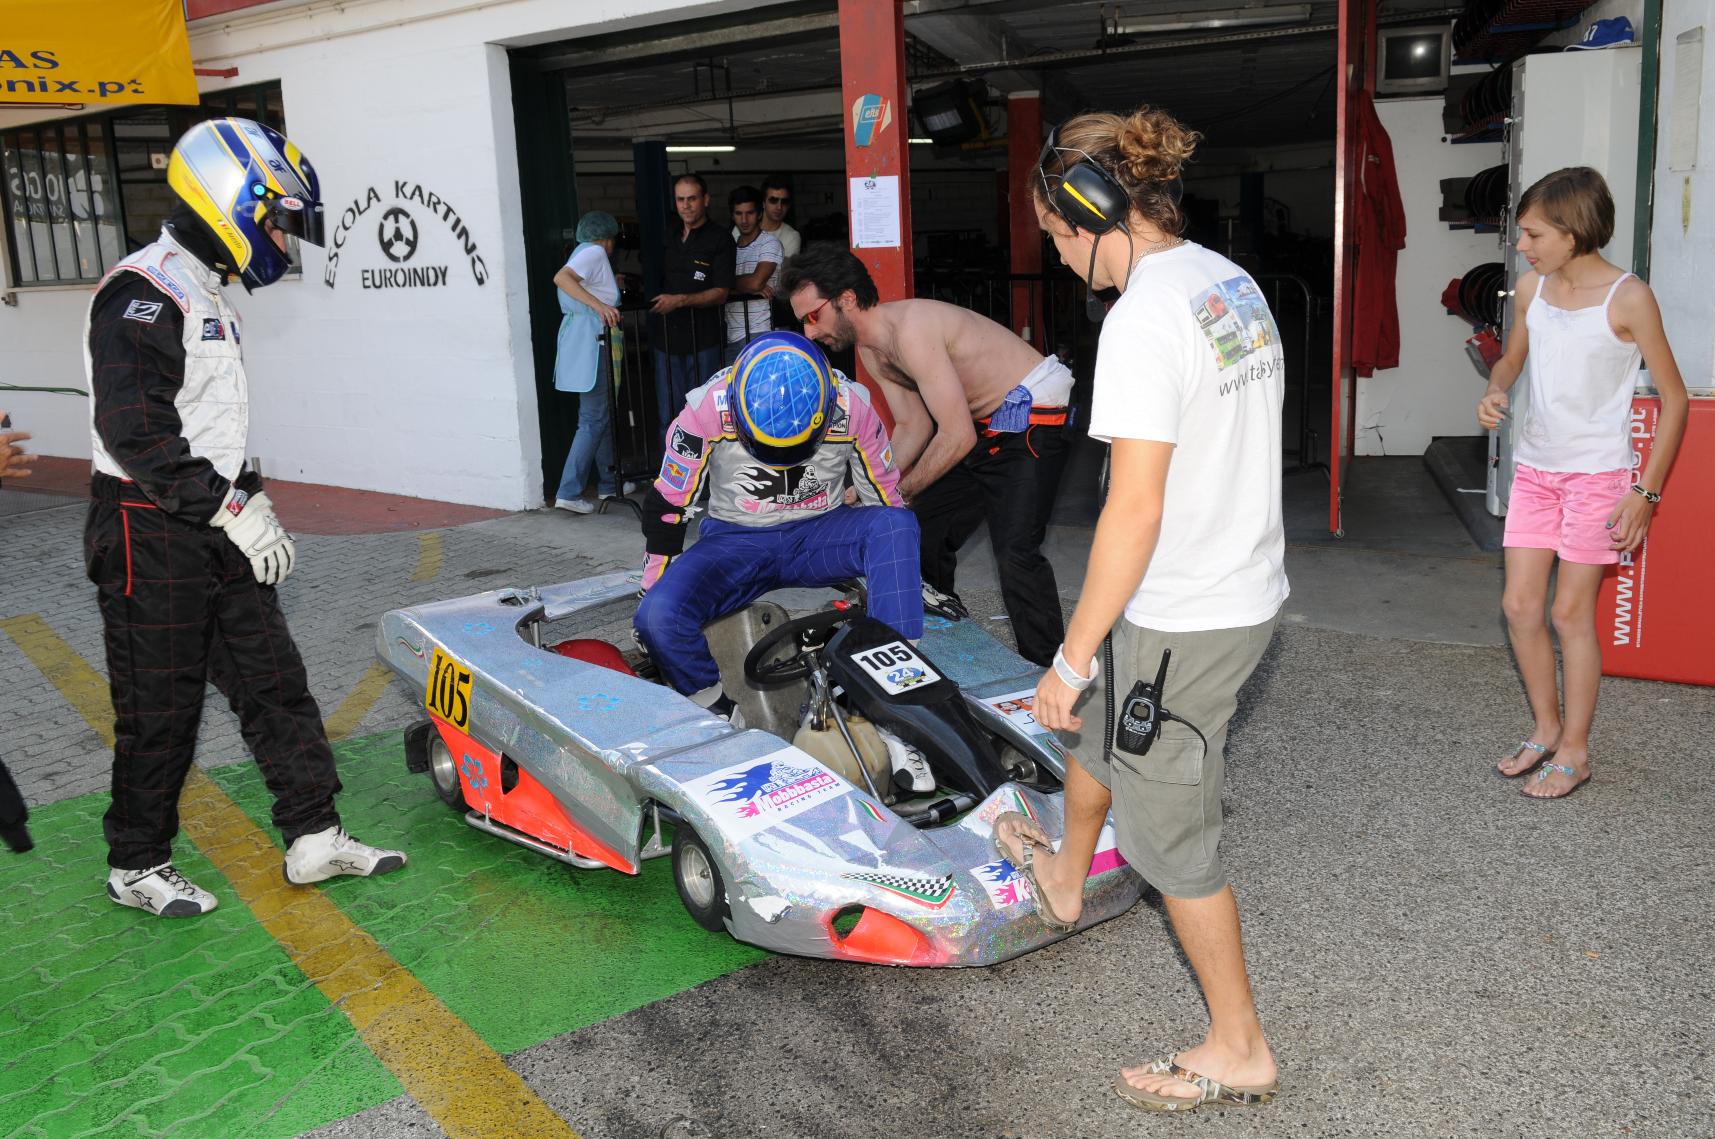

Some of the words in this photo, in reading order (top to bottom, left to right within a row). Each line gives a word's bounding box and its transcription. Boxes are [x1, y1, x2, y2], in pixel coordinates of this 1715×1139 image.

[0, 76, 145, 97] nix.pt
[324, 186, 382, 290] ESCOLA
[394, 180, 489, 287] KARTING
[361, 265, 448, 290] EUROINDY
[860, 645, 913, 671] 105
[889, 667, 915, 683] 24
[429, 654, 470, 728] 105
